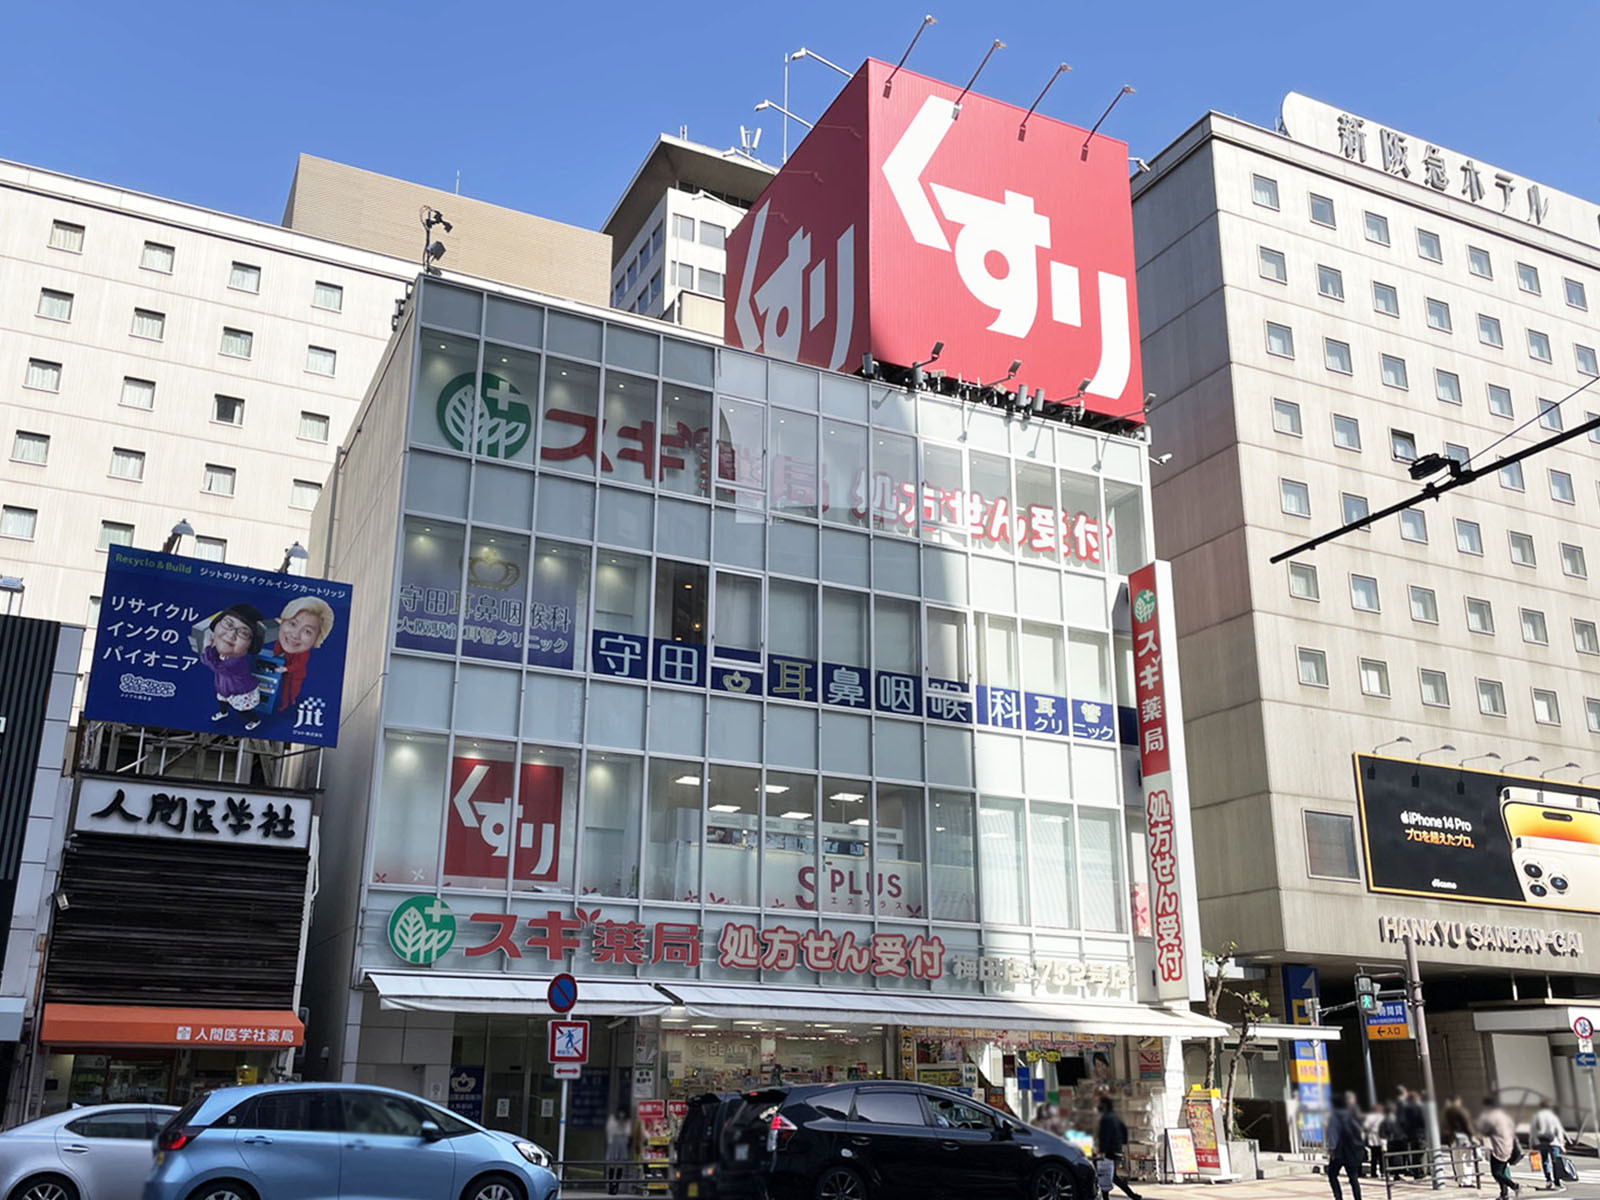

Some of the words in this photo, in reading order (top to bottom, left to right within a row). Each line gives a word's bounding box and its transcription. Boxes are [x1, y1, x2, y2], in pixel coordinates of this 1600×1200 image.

[1336, 113, 1549, 226] 新阪急ホテル
[881, 94, 1131, 400] くすり
[734, 197, 855, 372] くすり
[850, 469, 1112, 564] 処方せん受付
[107, 621, 180, 644] インクの
[111, 596, 199, 622] リサイクル
[102, 645, 199, 671] パイオニア
[292, 708, 325, 728] jit
[1137, 629, 1165, 755] スギ薬局
[1033, 716, 1115, 741] クリニック
[91, 788, 296, 839] 人間医学社
[453, 764, 555, 876] くすり
[1408, 811, 1443, 829] iPhone
[1442, 815, 1454, 830] 14
[1454, 817, 1472, 832] Pro
[1147, 789, 1184, 982] 処方せん受付
[463, 907, 701, 967] スギ薬局
[717, 921, 946, 981] 処方せん受付
[1381, 915, 1465, 946] HANKYU
[1468, 922, 1585, 956] SANBAN-GAI
[195, 1026, 295, 1044] 人間医学社薬局
